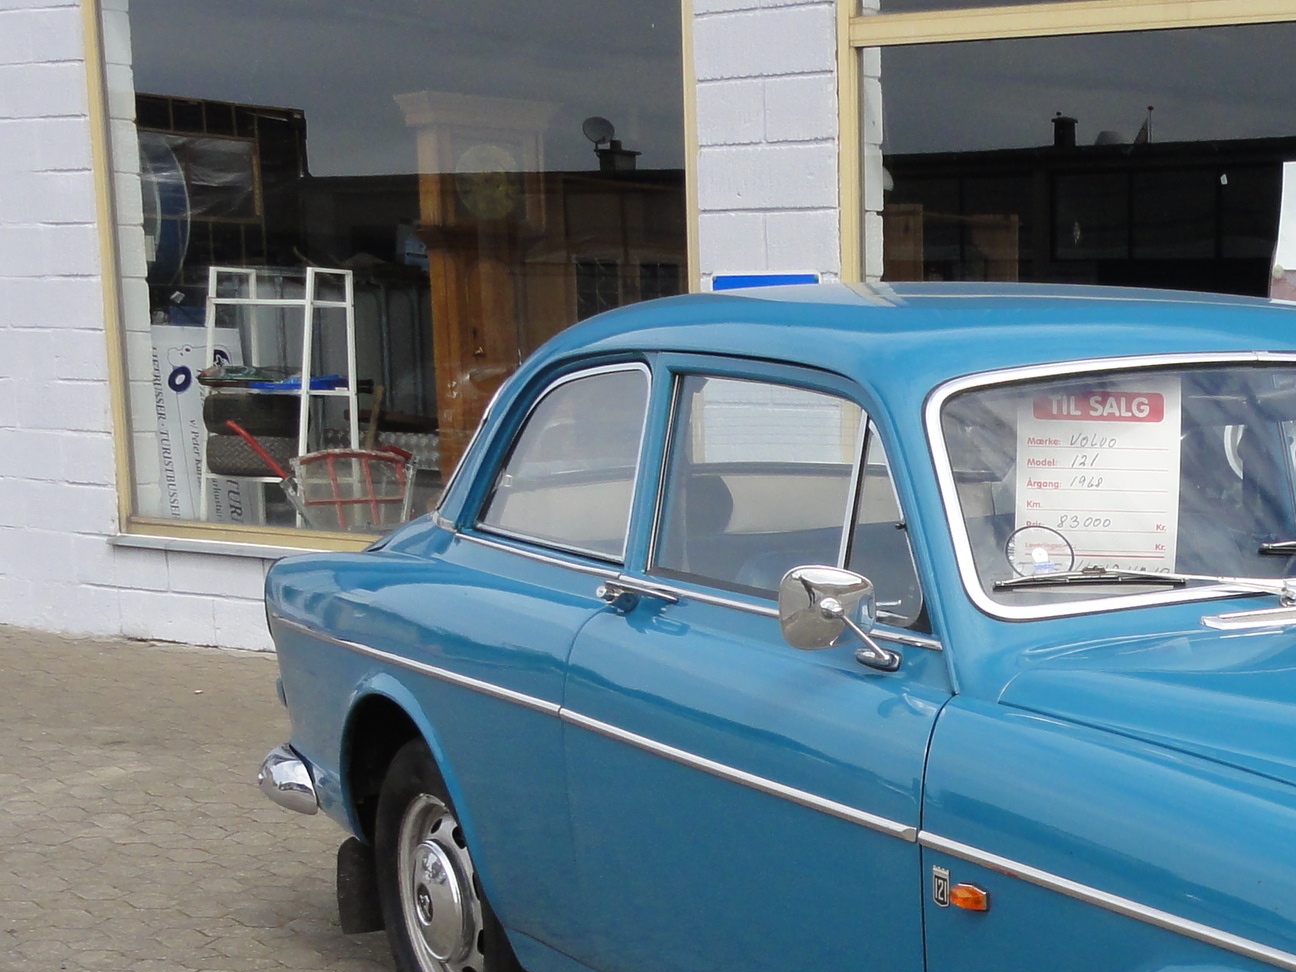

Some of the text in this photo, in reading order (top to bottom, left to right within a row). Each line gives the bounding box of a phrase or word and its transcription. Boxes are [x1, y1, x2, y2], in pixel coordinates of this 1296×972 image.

[1049, 395, 1150, 418] TIL SALG
[1026, 437, 1061, 446] Mærke:
[1026, 453, 1099, 468] Model: 121
[1069, 475, 1104, 489] 1968
[1156, 524, 1167, 532] Kr.
[1155, 543, 1166, 551] Kr.
